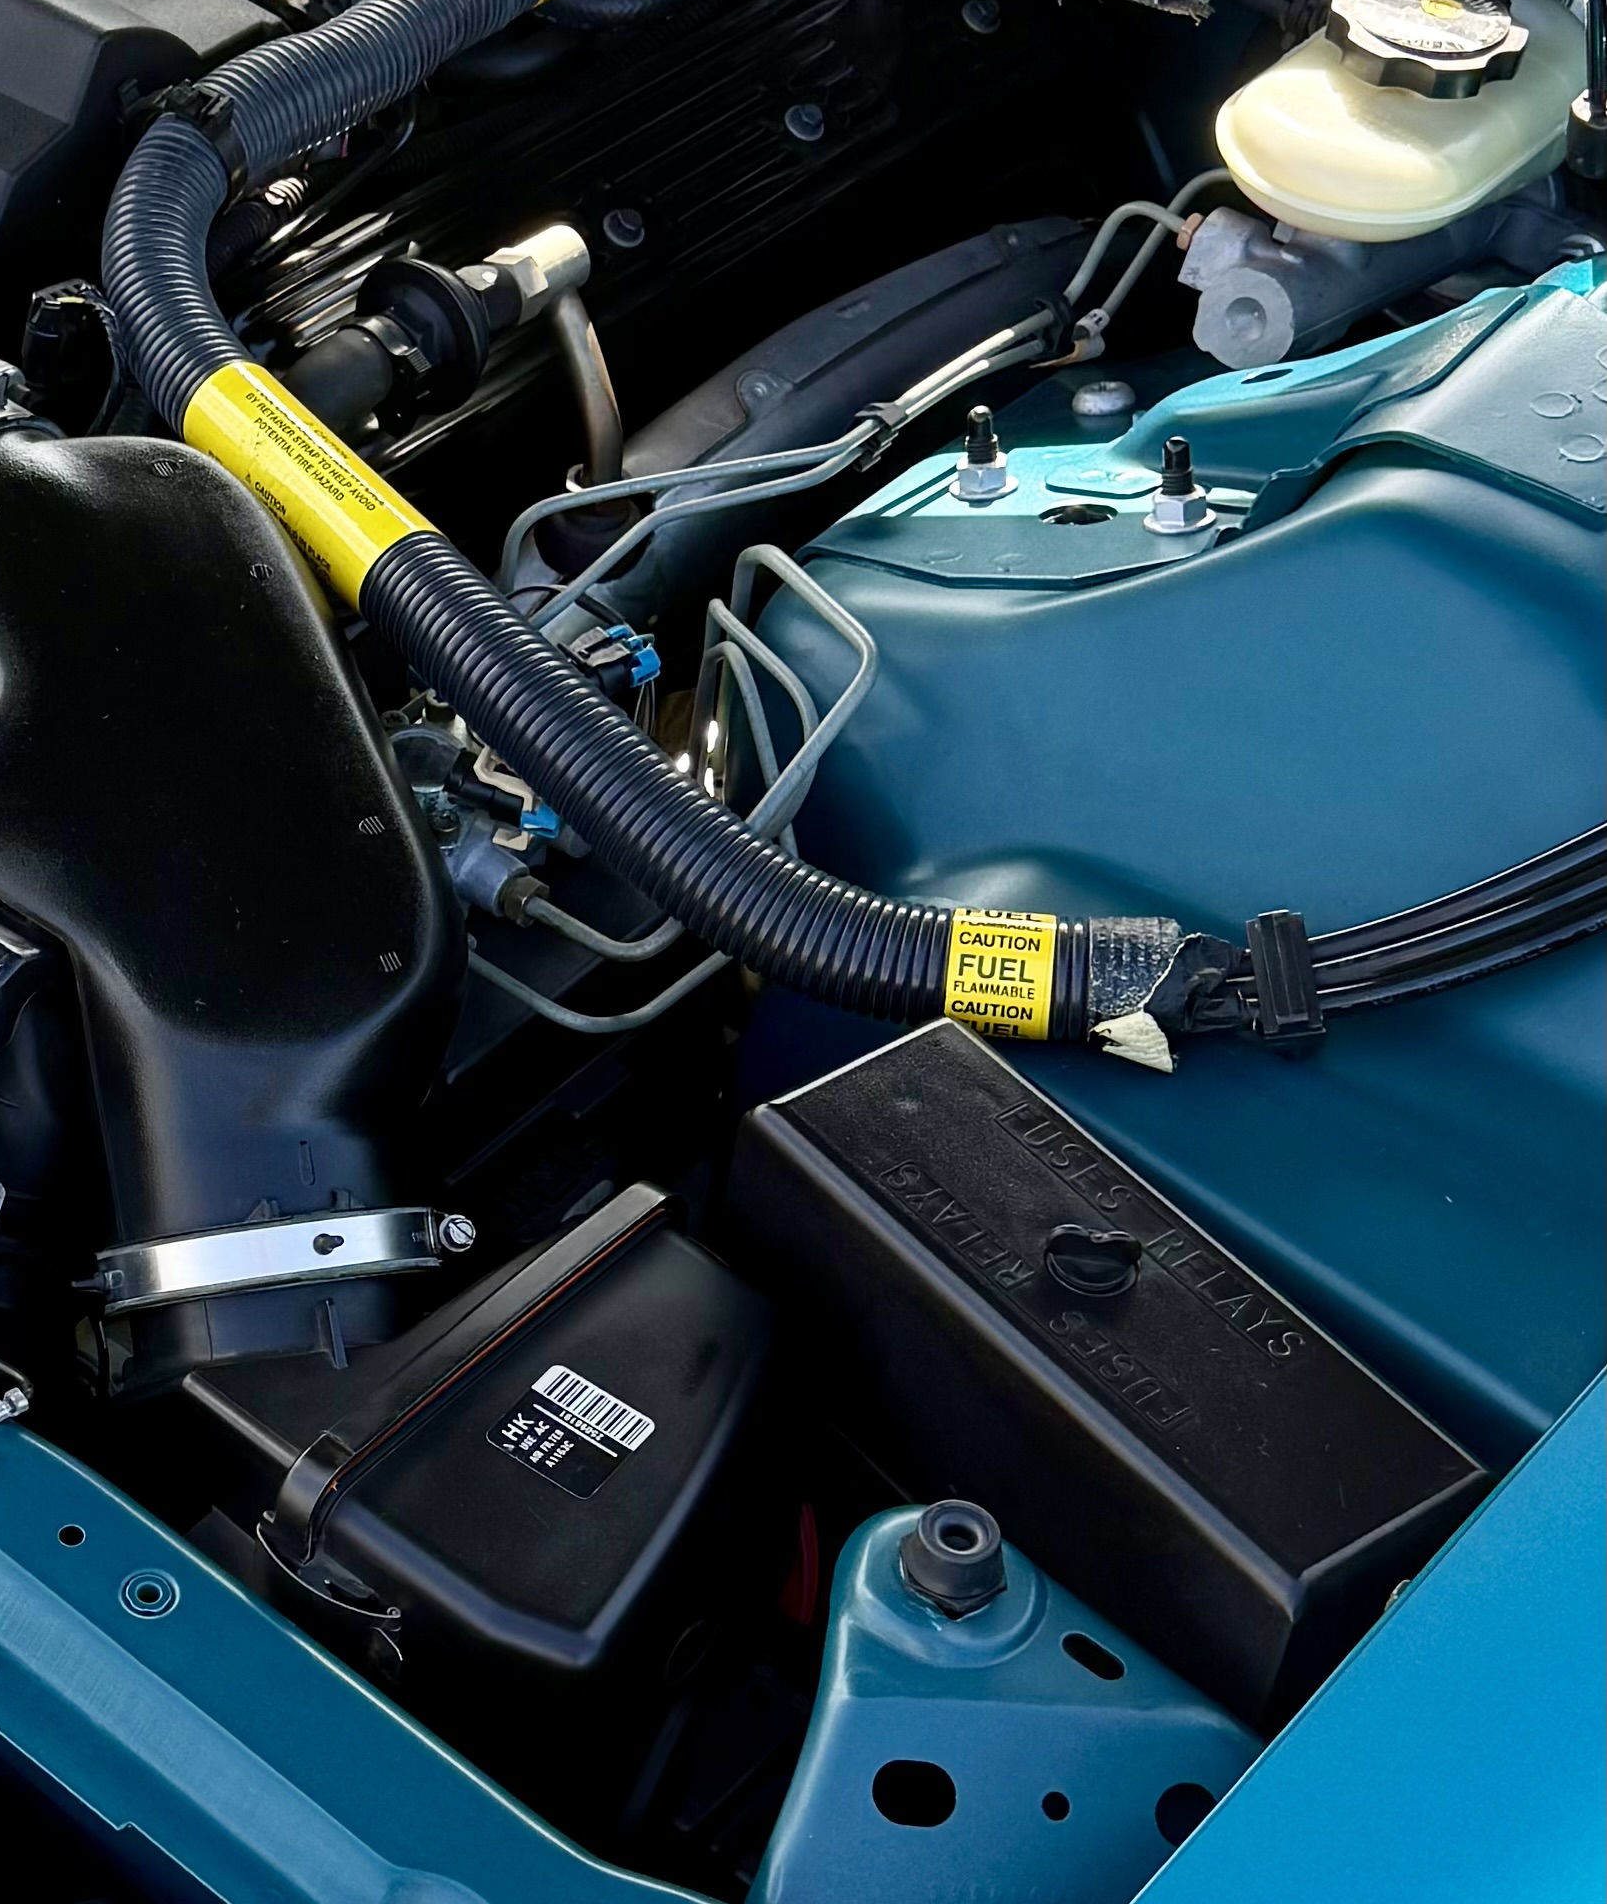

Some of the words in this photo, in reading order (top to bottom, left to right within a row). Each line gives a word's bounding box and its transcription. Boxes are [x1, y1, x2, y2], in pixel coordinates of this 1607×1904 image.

[244, 391, 260, 404] BY
[291, 434, 321, 461] STRAP
[316, 456, 332, 471] TO
[327, 467, 353, 490] HELP
[347, 486, 377, 512] AVOID
[252, 416, 297, 457] POTENTIAL
[291, 453, 315, 473] FIRE
[309, 469, 345, 502] HAZARD
[254, 481, 287, 516] CAUTION
[959, 931, 1041, 952] CAUTION
[958, 954, 1035, 984] FUEL
[953, 980, 1035, 1000] FLAMMABLE
[951, 1000, 1033, 1020] CAUTION
[999, 1095, 1136, 1220] FUSES
[1144, 1217, 1310, 1367] RELAYS
[1046, 1301, 1190, 1434] FUSES
[498, 1411, 536, 1442] HK
[530, 1419, 551, 1436] AC
